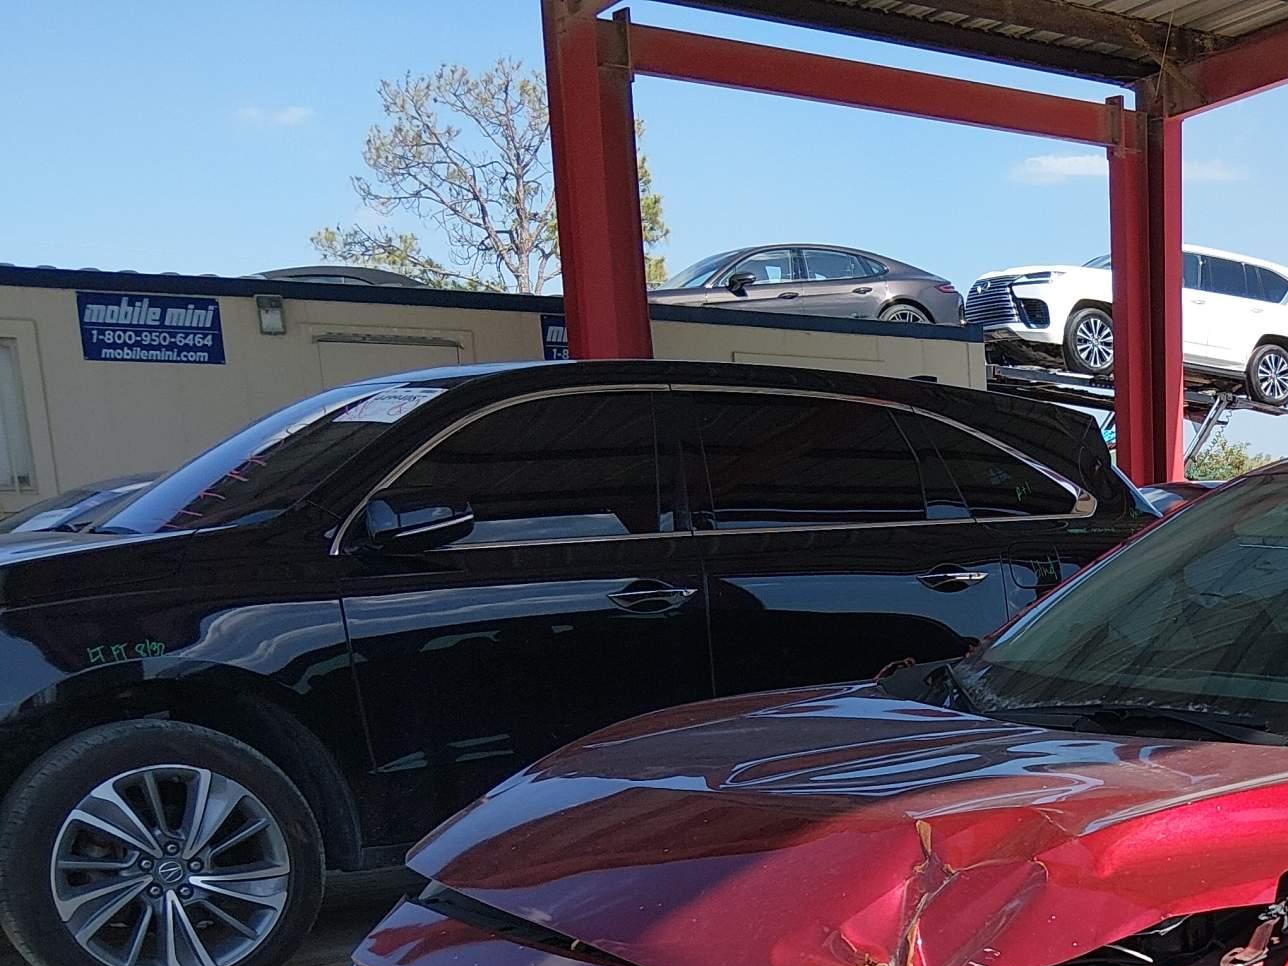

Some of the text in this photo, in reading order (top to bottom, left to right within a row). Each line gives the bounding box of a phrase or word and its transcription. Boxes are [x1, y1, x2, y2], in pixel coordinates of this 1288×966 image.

[83, 297, 215, 327] mobile mini
[91, 330, 213, 347] 1-800-950-6464
[100, 347, 209, 362] mobilemini.com
